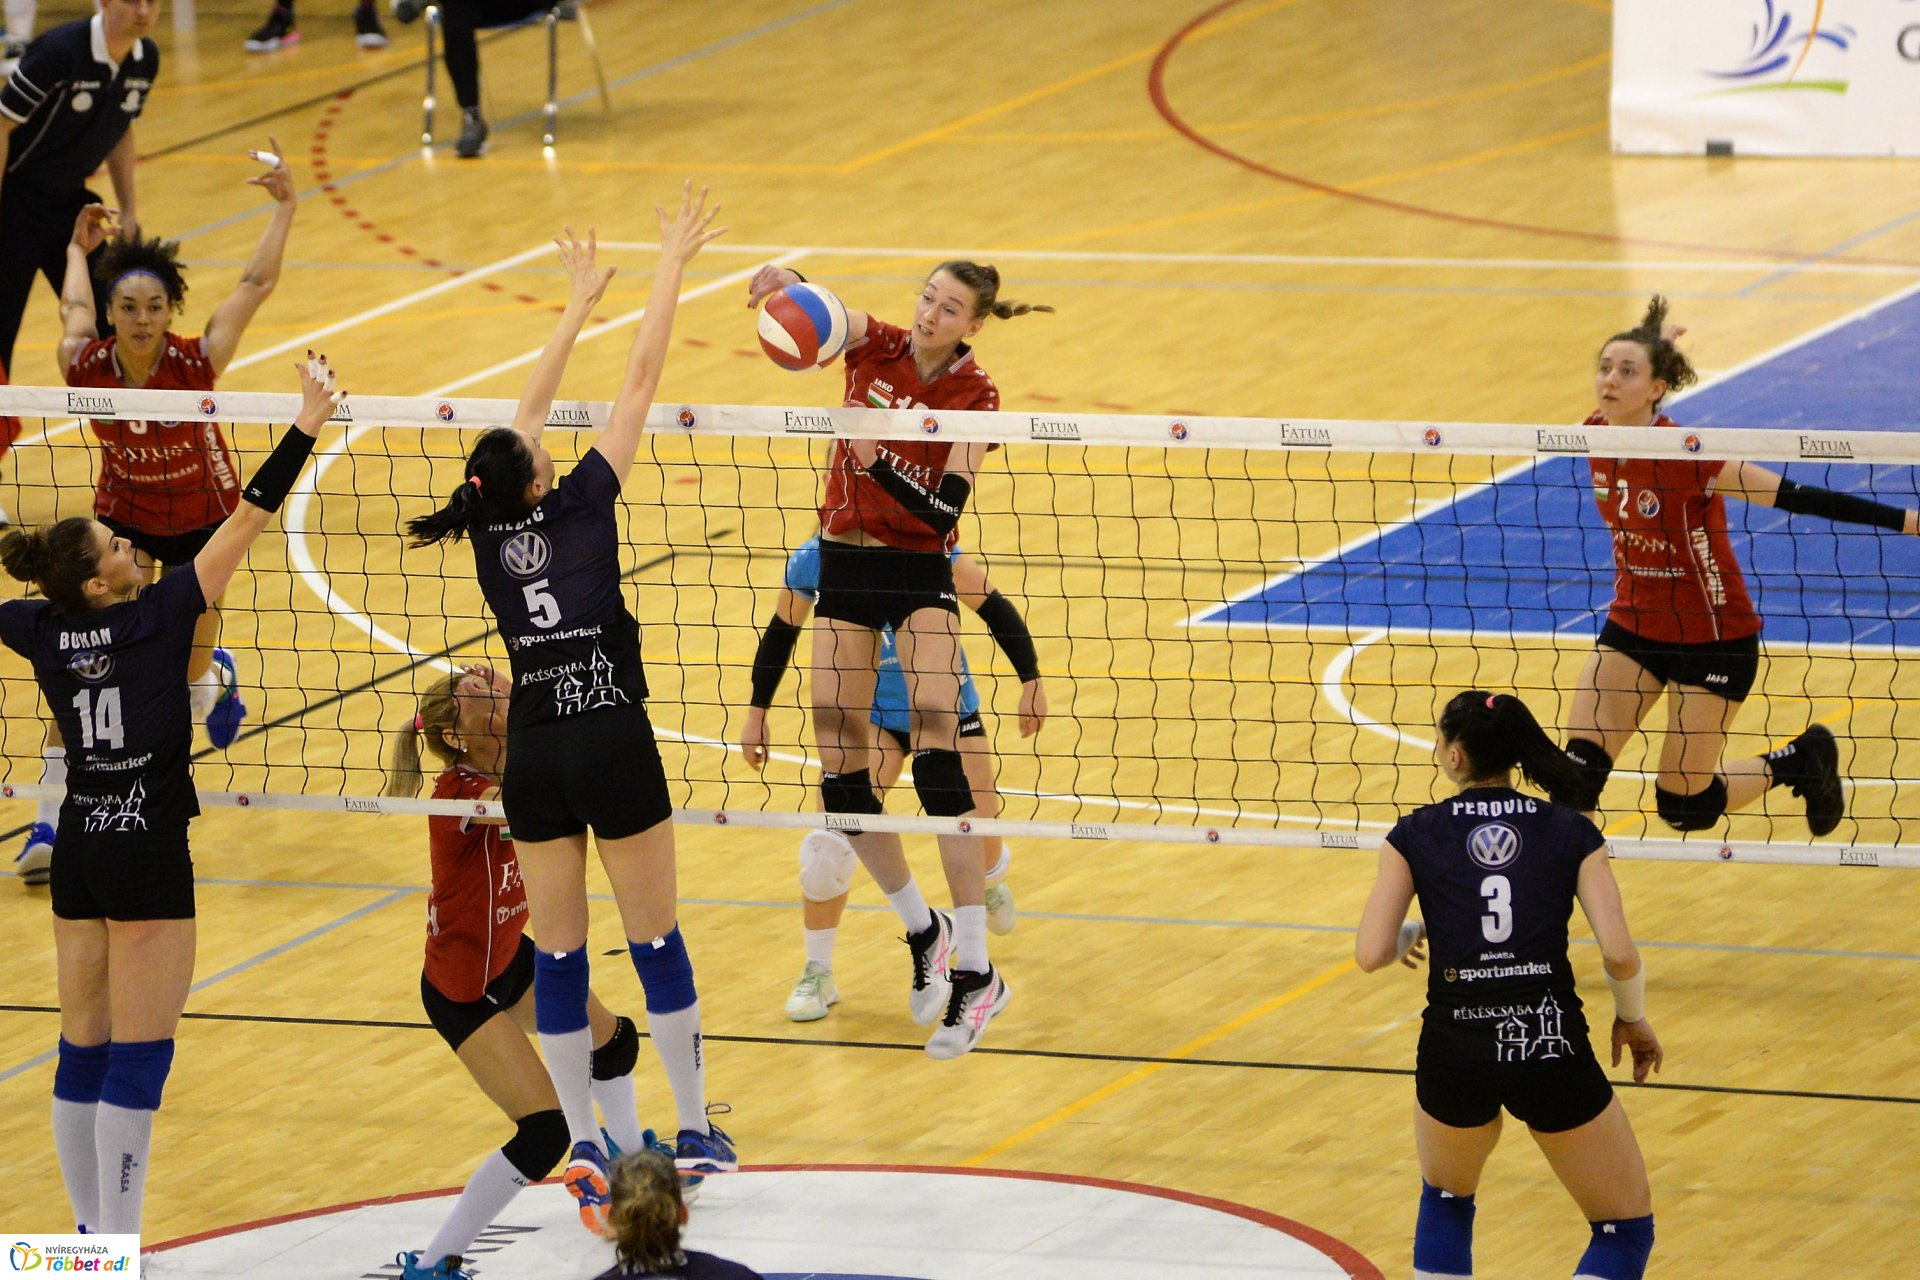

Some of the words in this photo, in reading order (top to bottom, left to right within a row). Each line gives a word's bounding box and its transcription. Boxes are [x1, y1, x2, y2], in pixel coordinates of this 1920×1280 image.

[874, 378, 894, 393] JAKO
[67, 392, 114, 408] FATUM
[550, 409, 591, 421] ATUM
[784, 411, 833, 427] FATUM
[1030, 417, 1080, 433] FATUM
[1280, 423, 1331, 440] FATUM
[1536, 429, 1588, 446] FATUM
[1799, 435, 1852, 452] FATUM
[1617, 479, 1629, 519] 2
[522, 578, 562, 629] 5
[59, 627, 112, 650] BOKAN
[72, 686, 125, 750] 14
[345, 798, 379, 809] FATUM
[825, 815, 861, 827] FATUM
[1071, 824, 1107, 836] FATUM
[1321, 832, 1358, 844] FATUM
[1840, 849, 1878, 861] FATUM
[1480, 874, 1513, 943] 3
[1459, 962, 1553, 982] sportmarket
[1453, 1004, 1534, 1020] BÉKÉSCSABA
